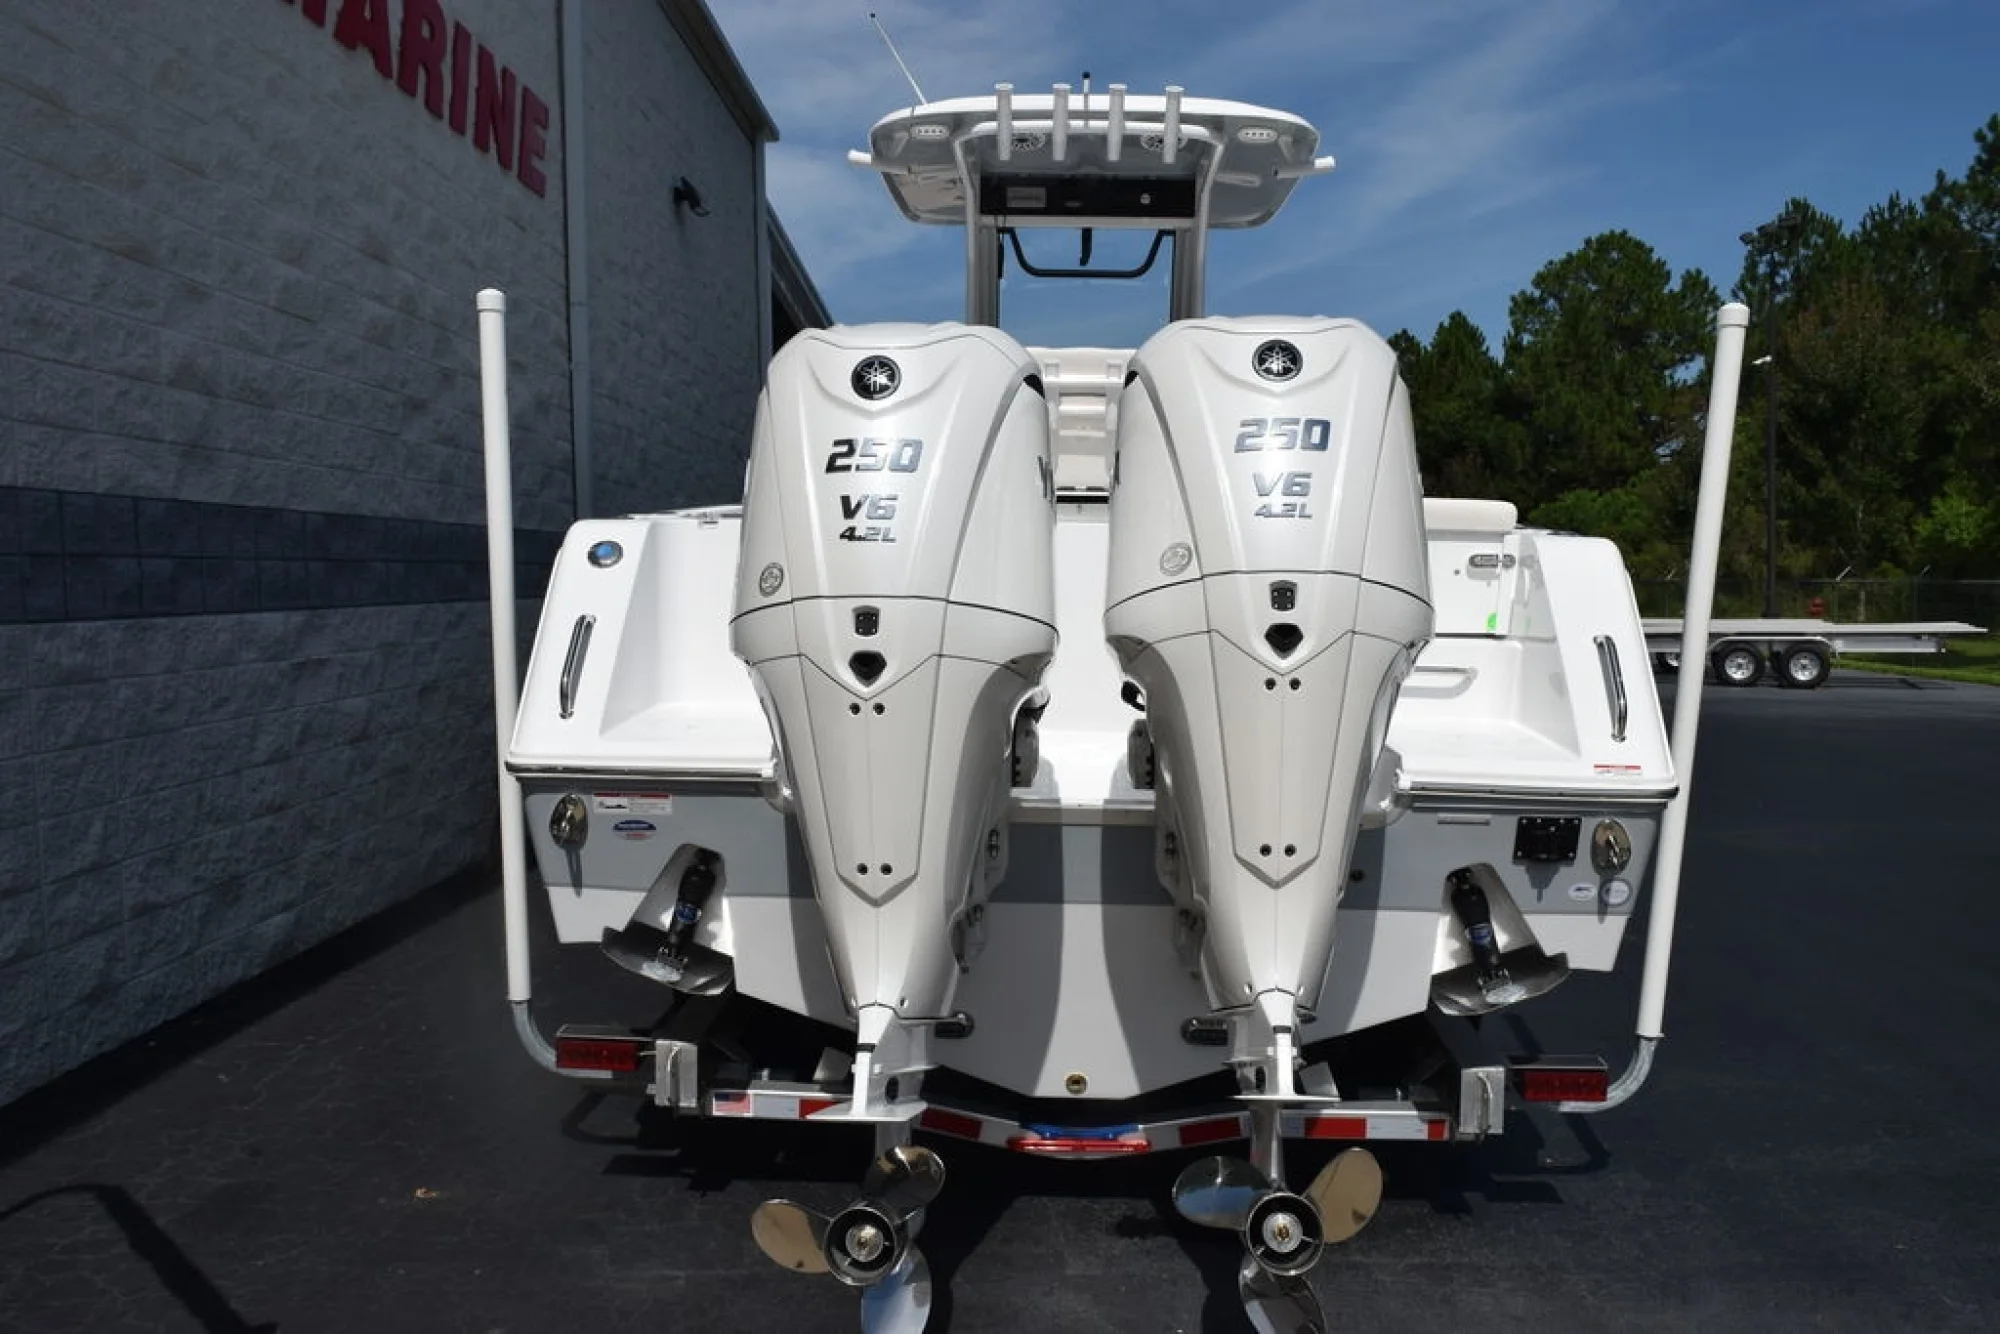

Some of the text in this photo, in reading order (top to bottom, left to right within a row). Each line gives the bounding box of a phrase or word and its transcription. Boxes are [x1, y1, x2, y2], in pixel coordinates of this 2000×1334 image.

[279, 0, 549, 200] ARINE
[1234, 417, 1331, 453] 250
[825, 438, 923, 473] 250
[1252, 472, 1312, 497] V6
[840, 494, 898, 520] V6
